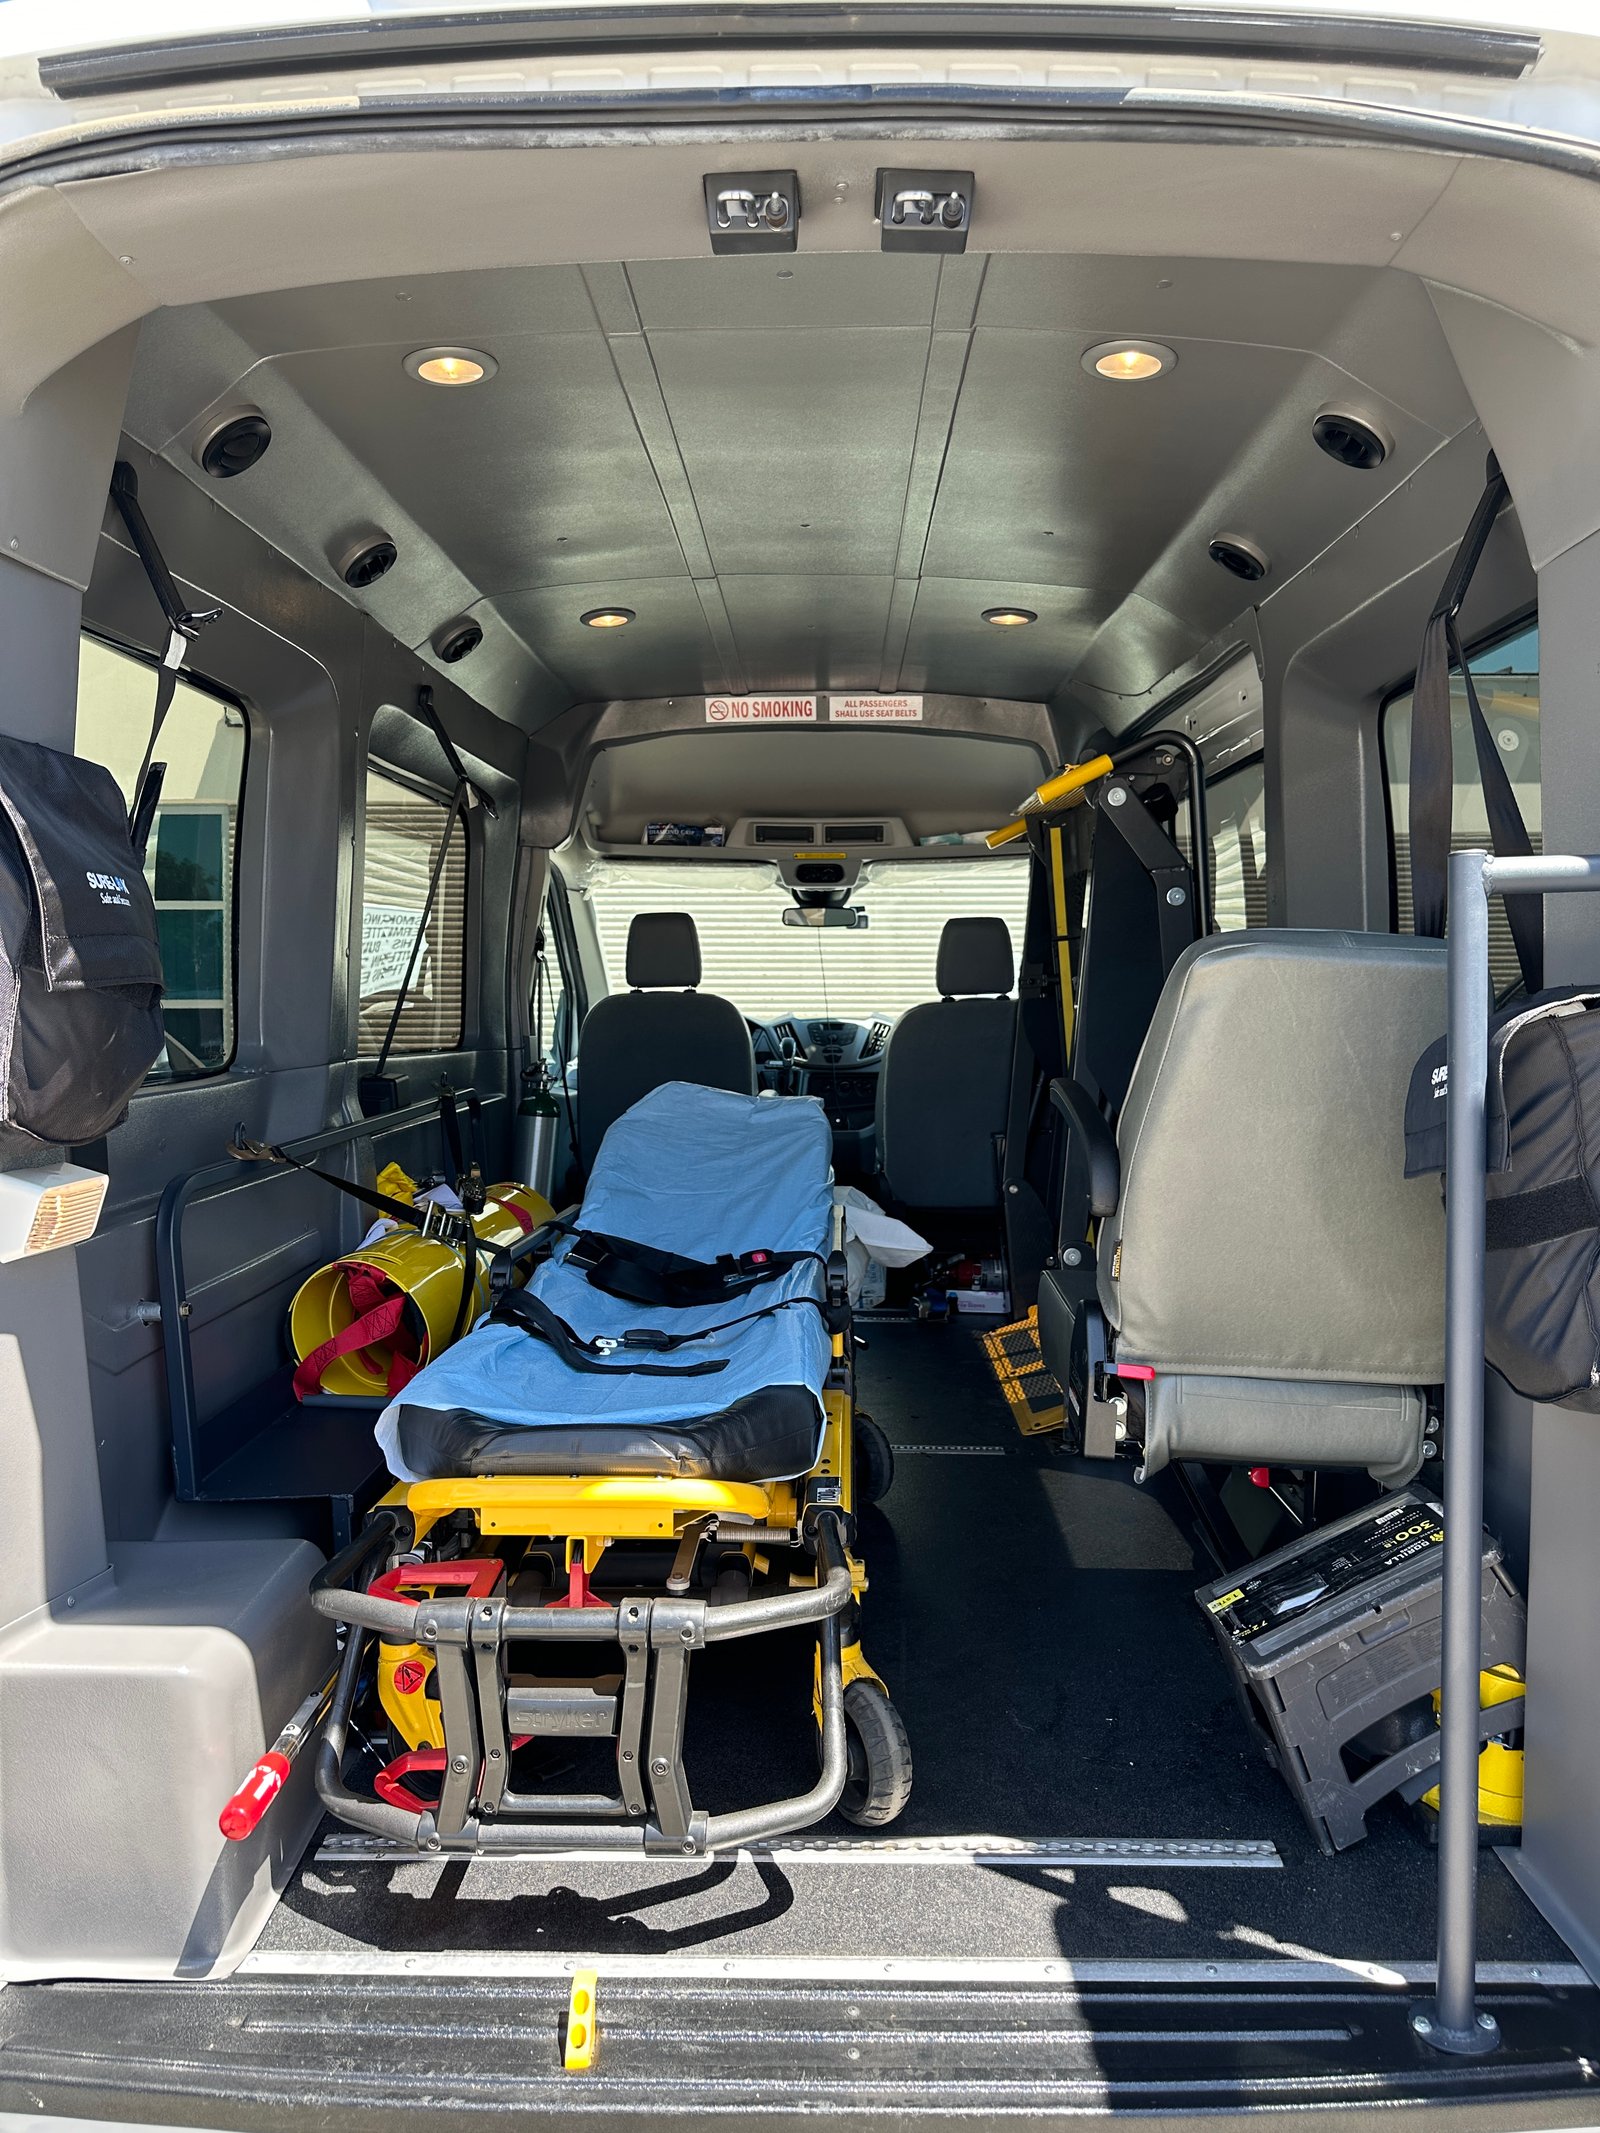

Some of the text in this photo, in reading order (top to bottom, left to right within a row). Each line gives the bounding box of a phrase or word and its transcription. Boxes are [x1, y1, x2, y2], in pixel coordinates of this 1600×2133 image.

[731, 700, 813, 718] NO SMOKING
[835, 709, 918, 718] SHALL USE SEAT BELTS
[844, 700, 908, 708] ALL PASSENGERS
[1395, 1520, 1435, 1541] 300
[1384, 1540, 1430, 1565] GORILLA
[513, 1704, 608, 1731] stryker
